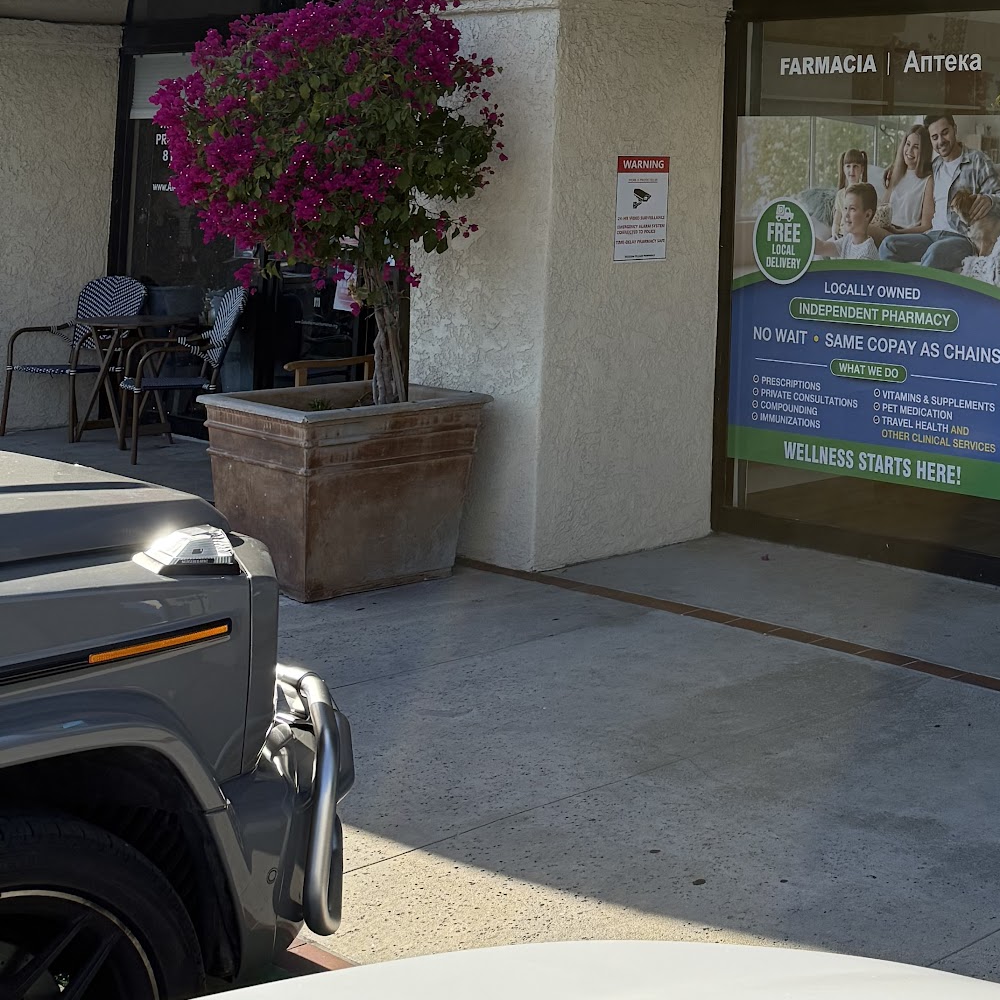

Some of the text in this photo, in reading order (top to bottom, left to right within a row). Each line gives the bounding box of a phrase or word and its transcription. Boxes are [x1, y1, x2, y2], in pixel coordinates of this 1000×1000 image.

[780, 54, 876, 75] FARMACIA
[904, 51, 982, 73] Аптека
[624, 160, 664, 168] WARNING
[767, 222, 800, 242] FREE
[772, 244, 795, 256] LOCAL
[766, 256, 801, 269] DELIVERY
[824, 282, 920, 300] LOCALLY OWNED
[799, 302, 950, 327] INDEPENDENT PHARMACY
[754, 326, 772, 341] NO
[775, 328, 807, 344] WAIT
[825, 333, 864, 350] SAME
[867, 336, 917, 355] COPAY
[920, 342, 940, 358] AS
[839, 362, 899, 378] WHAT WE DO
[761, 376, 821, 391] PRESCRIPTIONS
[761, 389, 858, 408] PRIVATE CONSULTATIONS
[882, 390, 996, 412] VITAMINS & SUPPLEMENTS
[760, 401, 818, 416] COMPOUNDING
[882, 403, 953, 420] PET MEDICATION
[760, 413, 821, 429] IMMUNIZATIONS
[882, 416, 969, 436] TRAVEL HEALTH AND
[882, 430, 996, 453] OTHER CLINICAL SERVICES
[784, 441, 961, 485] WELLNESS STARTS HERE!
